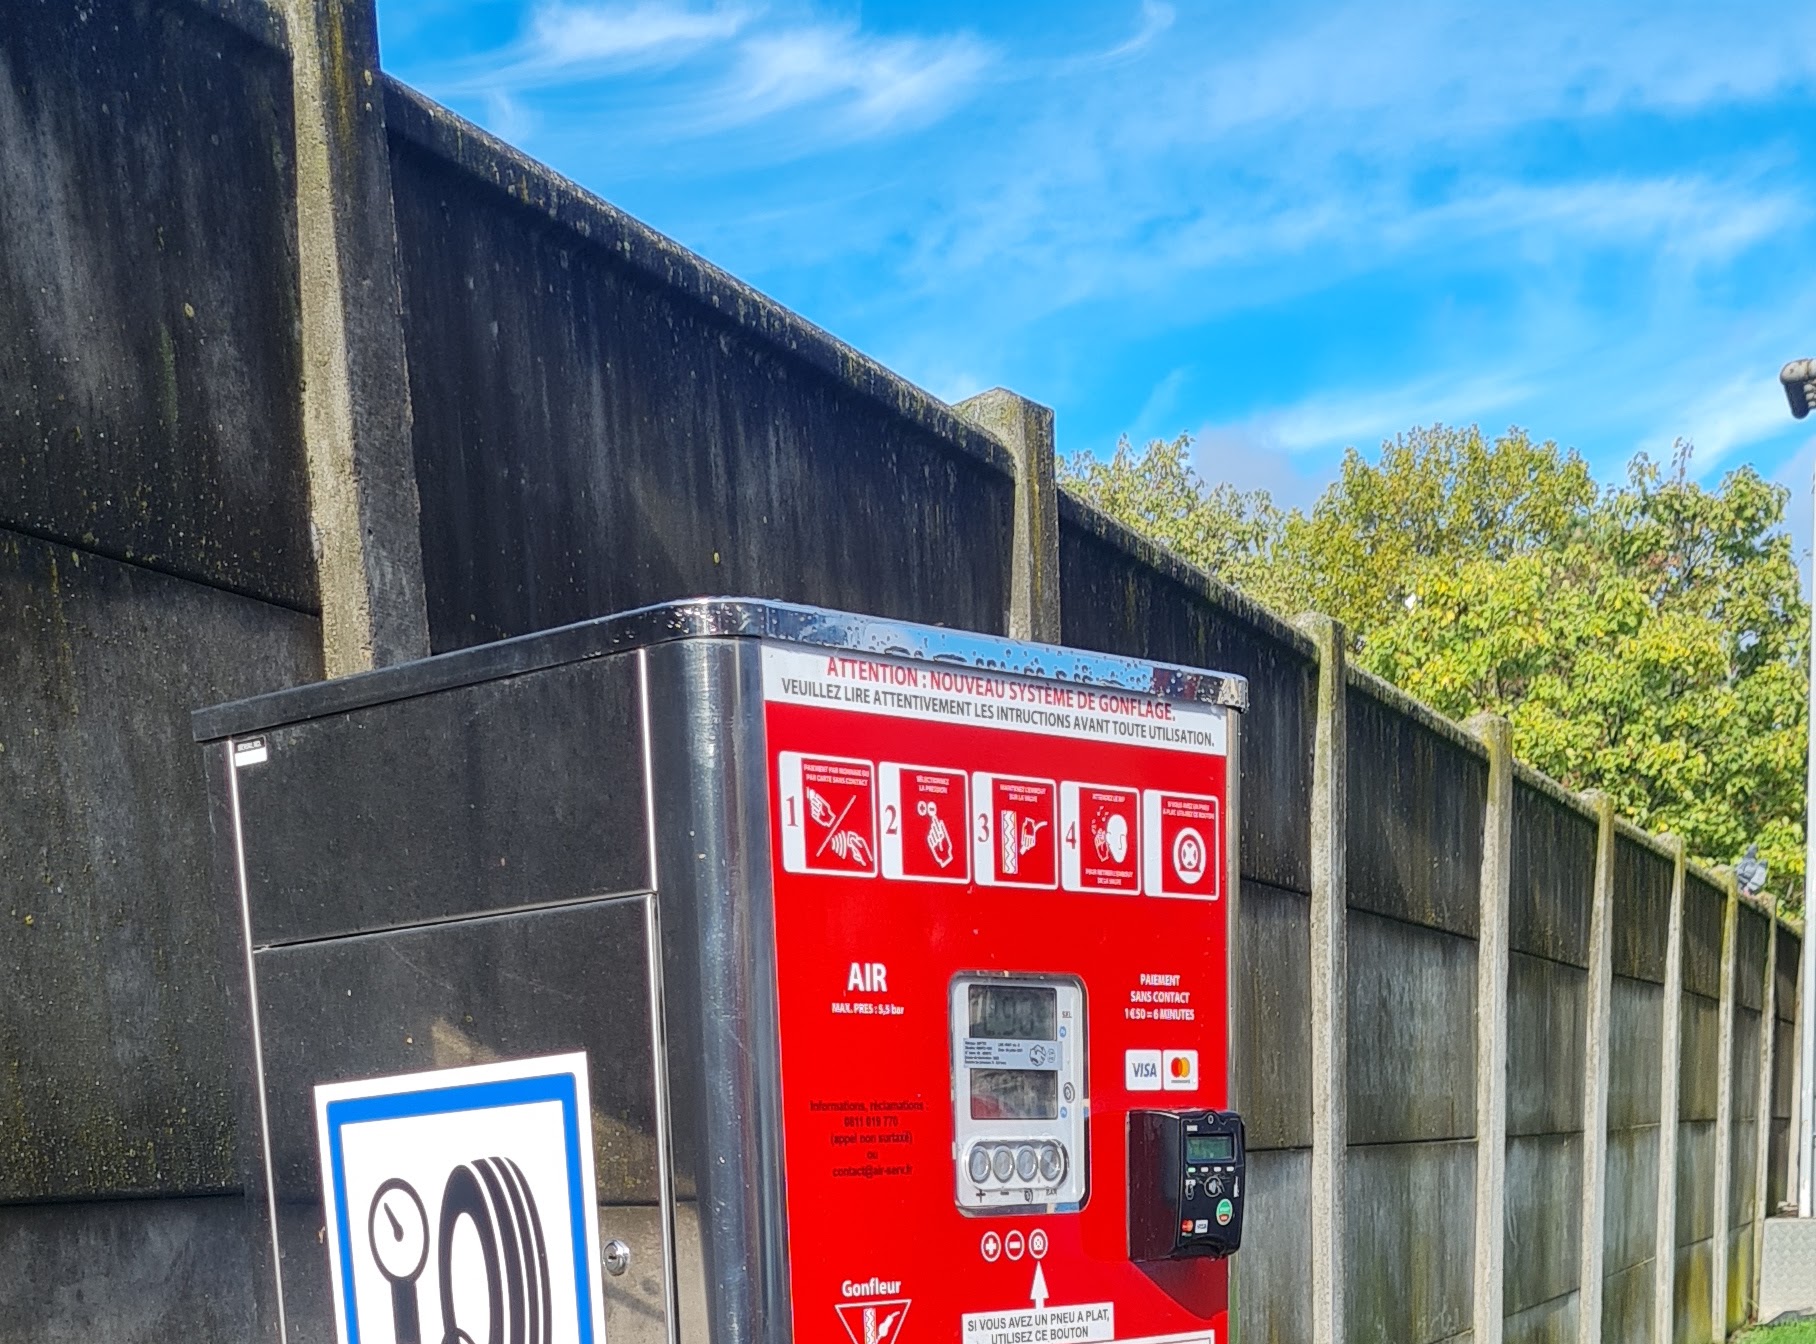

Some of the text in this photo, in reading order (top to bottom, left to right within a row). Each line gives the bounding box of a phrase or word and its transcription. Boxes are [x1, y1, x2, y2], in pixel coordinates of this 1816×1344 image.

[827, 656, 918, 687] ATTENTION
[930, 670, 1005, 698] NOUVEAU
[1009, 681, 1074, 708] SYSTÈME
[1077, 691, 1095, 711] DE
[1100, 694, 1176, 721] GONFLAGE.
[781, 677, 1215, 747] VEUILLEZ LIRE ATTENTIVEMENT LES INTRUCTIONS AVANT TOUTE UTILISATION.
[786, 796, 798, 827] 1
[885, 805, 898, 835] 2
[978, 813, 989, 842] 3
[1065, 821, 1076, 849] 4
[847, 962, 888, 992] AIR
[1140, 974, 1180, 986] PAIEMENT
[853, 1003, 873, 1014] PRES
[1130, 991, 1190, 1004] SANS CONTACT
[1153, 1008, 1158, 1020] 6
[1160, 1009, 1195, 1020] MINUTES
[1132, 1062, 1157, 1077] VISA
[841, 1277, 901, 1297] Gonfleur
[968, 1308, 1110, 1332] SI VOUS AVEZ UN PNEU A PLAT,
[1035, 1330, 1048, 1341] CE
[1051, 1326, 1089, 1340] BOUTON
